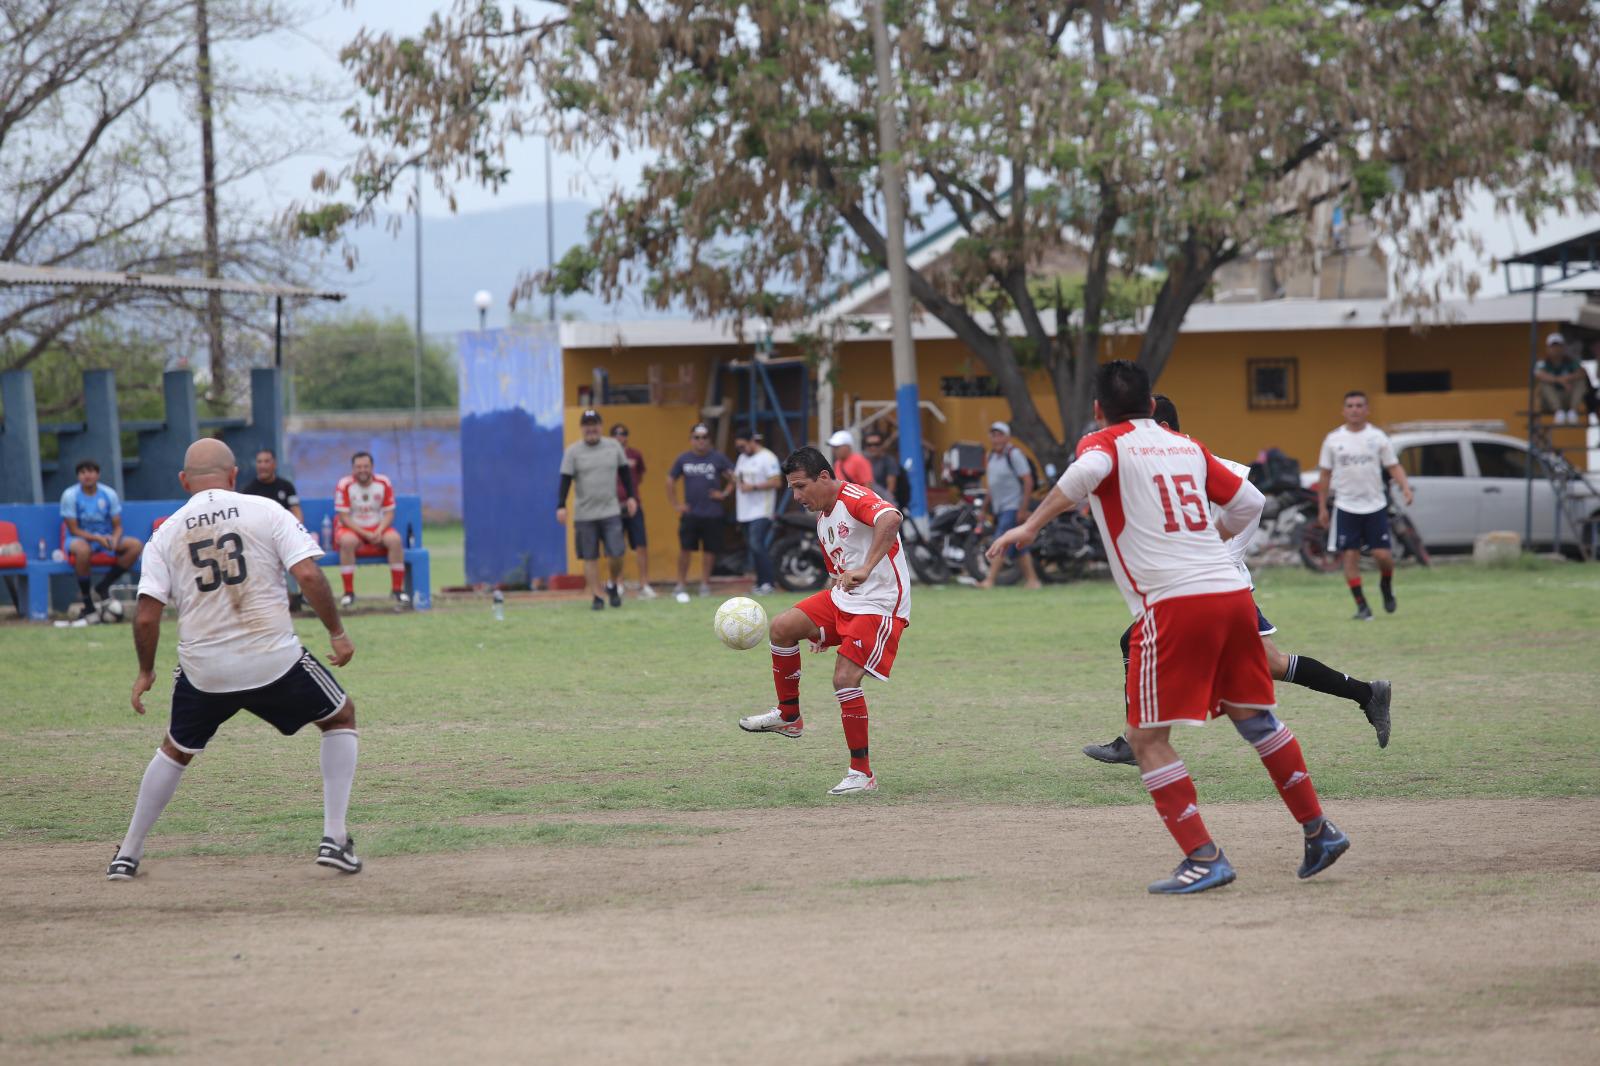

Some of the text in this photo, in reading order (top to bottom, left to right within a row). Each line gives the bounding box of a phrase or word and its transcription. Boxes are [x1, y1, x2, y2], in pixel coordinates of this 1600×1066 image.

[185, 506, 240, 530] CAMA
[1153, 473, 1208, 533] 15
[188, 532, 248, 593] 53
